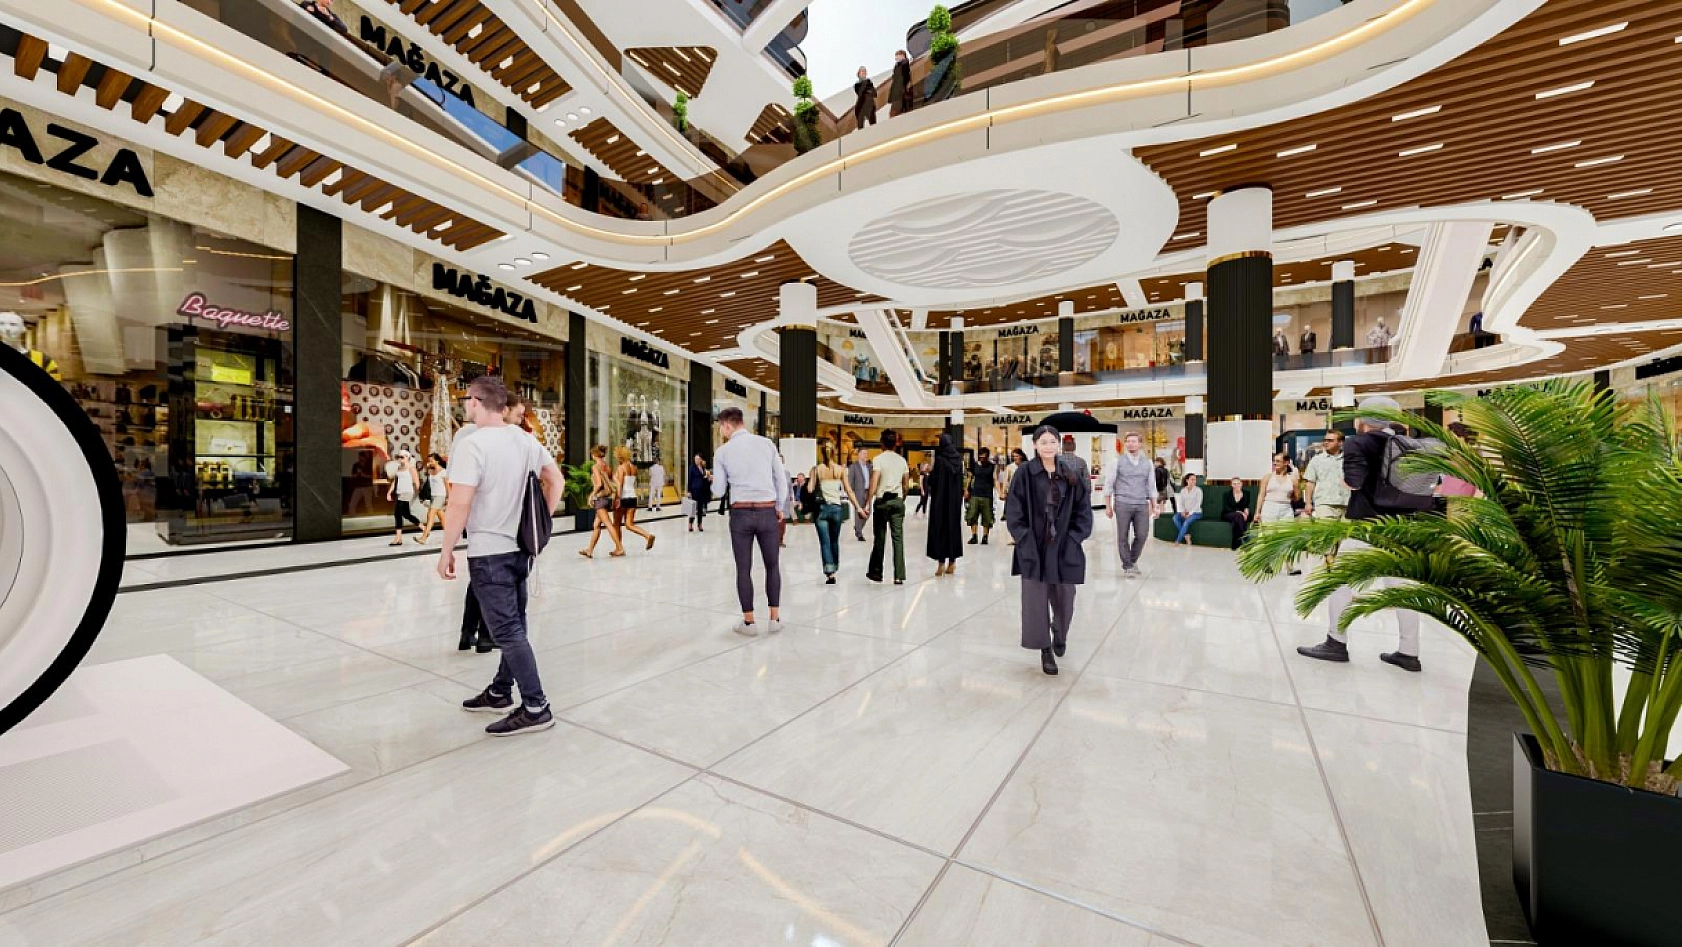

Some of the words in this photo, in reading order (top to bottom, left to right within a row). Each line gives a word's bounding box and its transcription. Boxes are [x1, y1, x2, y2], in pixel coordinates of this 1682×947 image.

[361, 15, 475, 107] MAĞAZA
[433, 264, 537, 323] MAĞAZA
[179, 293, 290, 331] Baguette
[1120, 308, 1170, 323] MAĞAZA
[999, 325, 1039, 337] MAĞAZA
[1124, 407, 1172, 418] MAĞAZA
